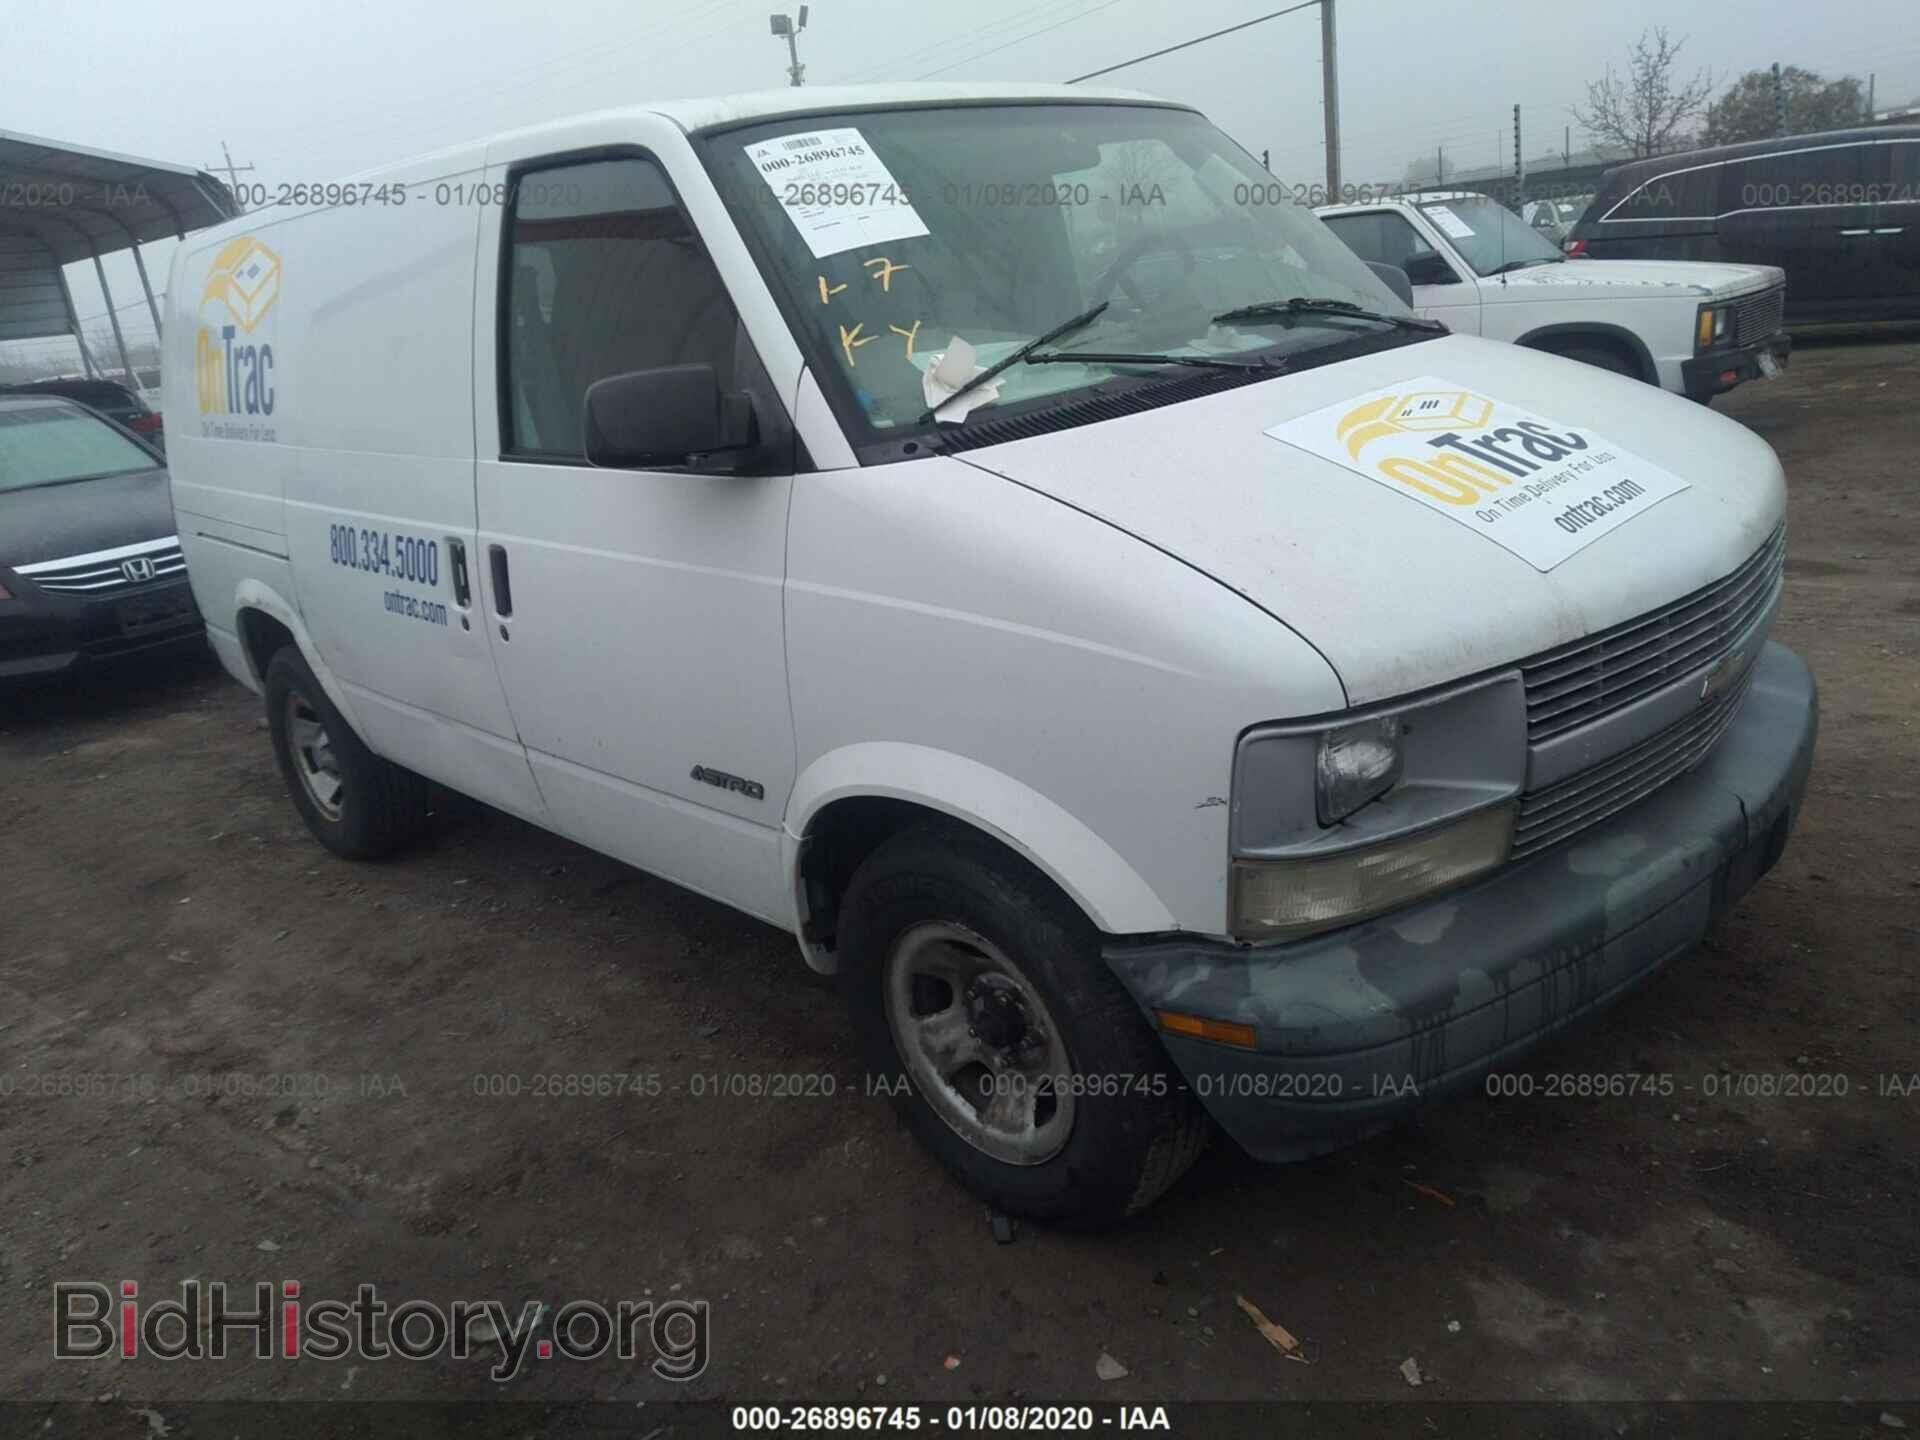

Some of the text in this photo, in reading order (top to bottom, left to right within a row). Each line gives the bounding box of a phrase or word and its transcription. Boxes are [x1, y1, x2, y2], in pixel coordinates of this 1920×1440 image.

[761, 145, 865, 174] 000-26896745
[195, 325, 275, 416] OnTrac
[1377, 421, 1589, 506] OnTrac
[1475, 451, 1617, 523] On Time Delivery For Less
[1554, 478, 1646, 534] ontrac.com
[330, 523, 438, 587] 800.334.5000
[384, 590, 448, 627] ontrac.com
